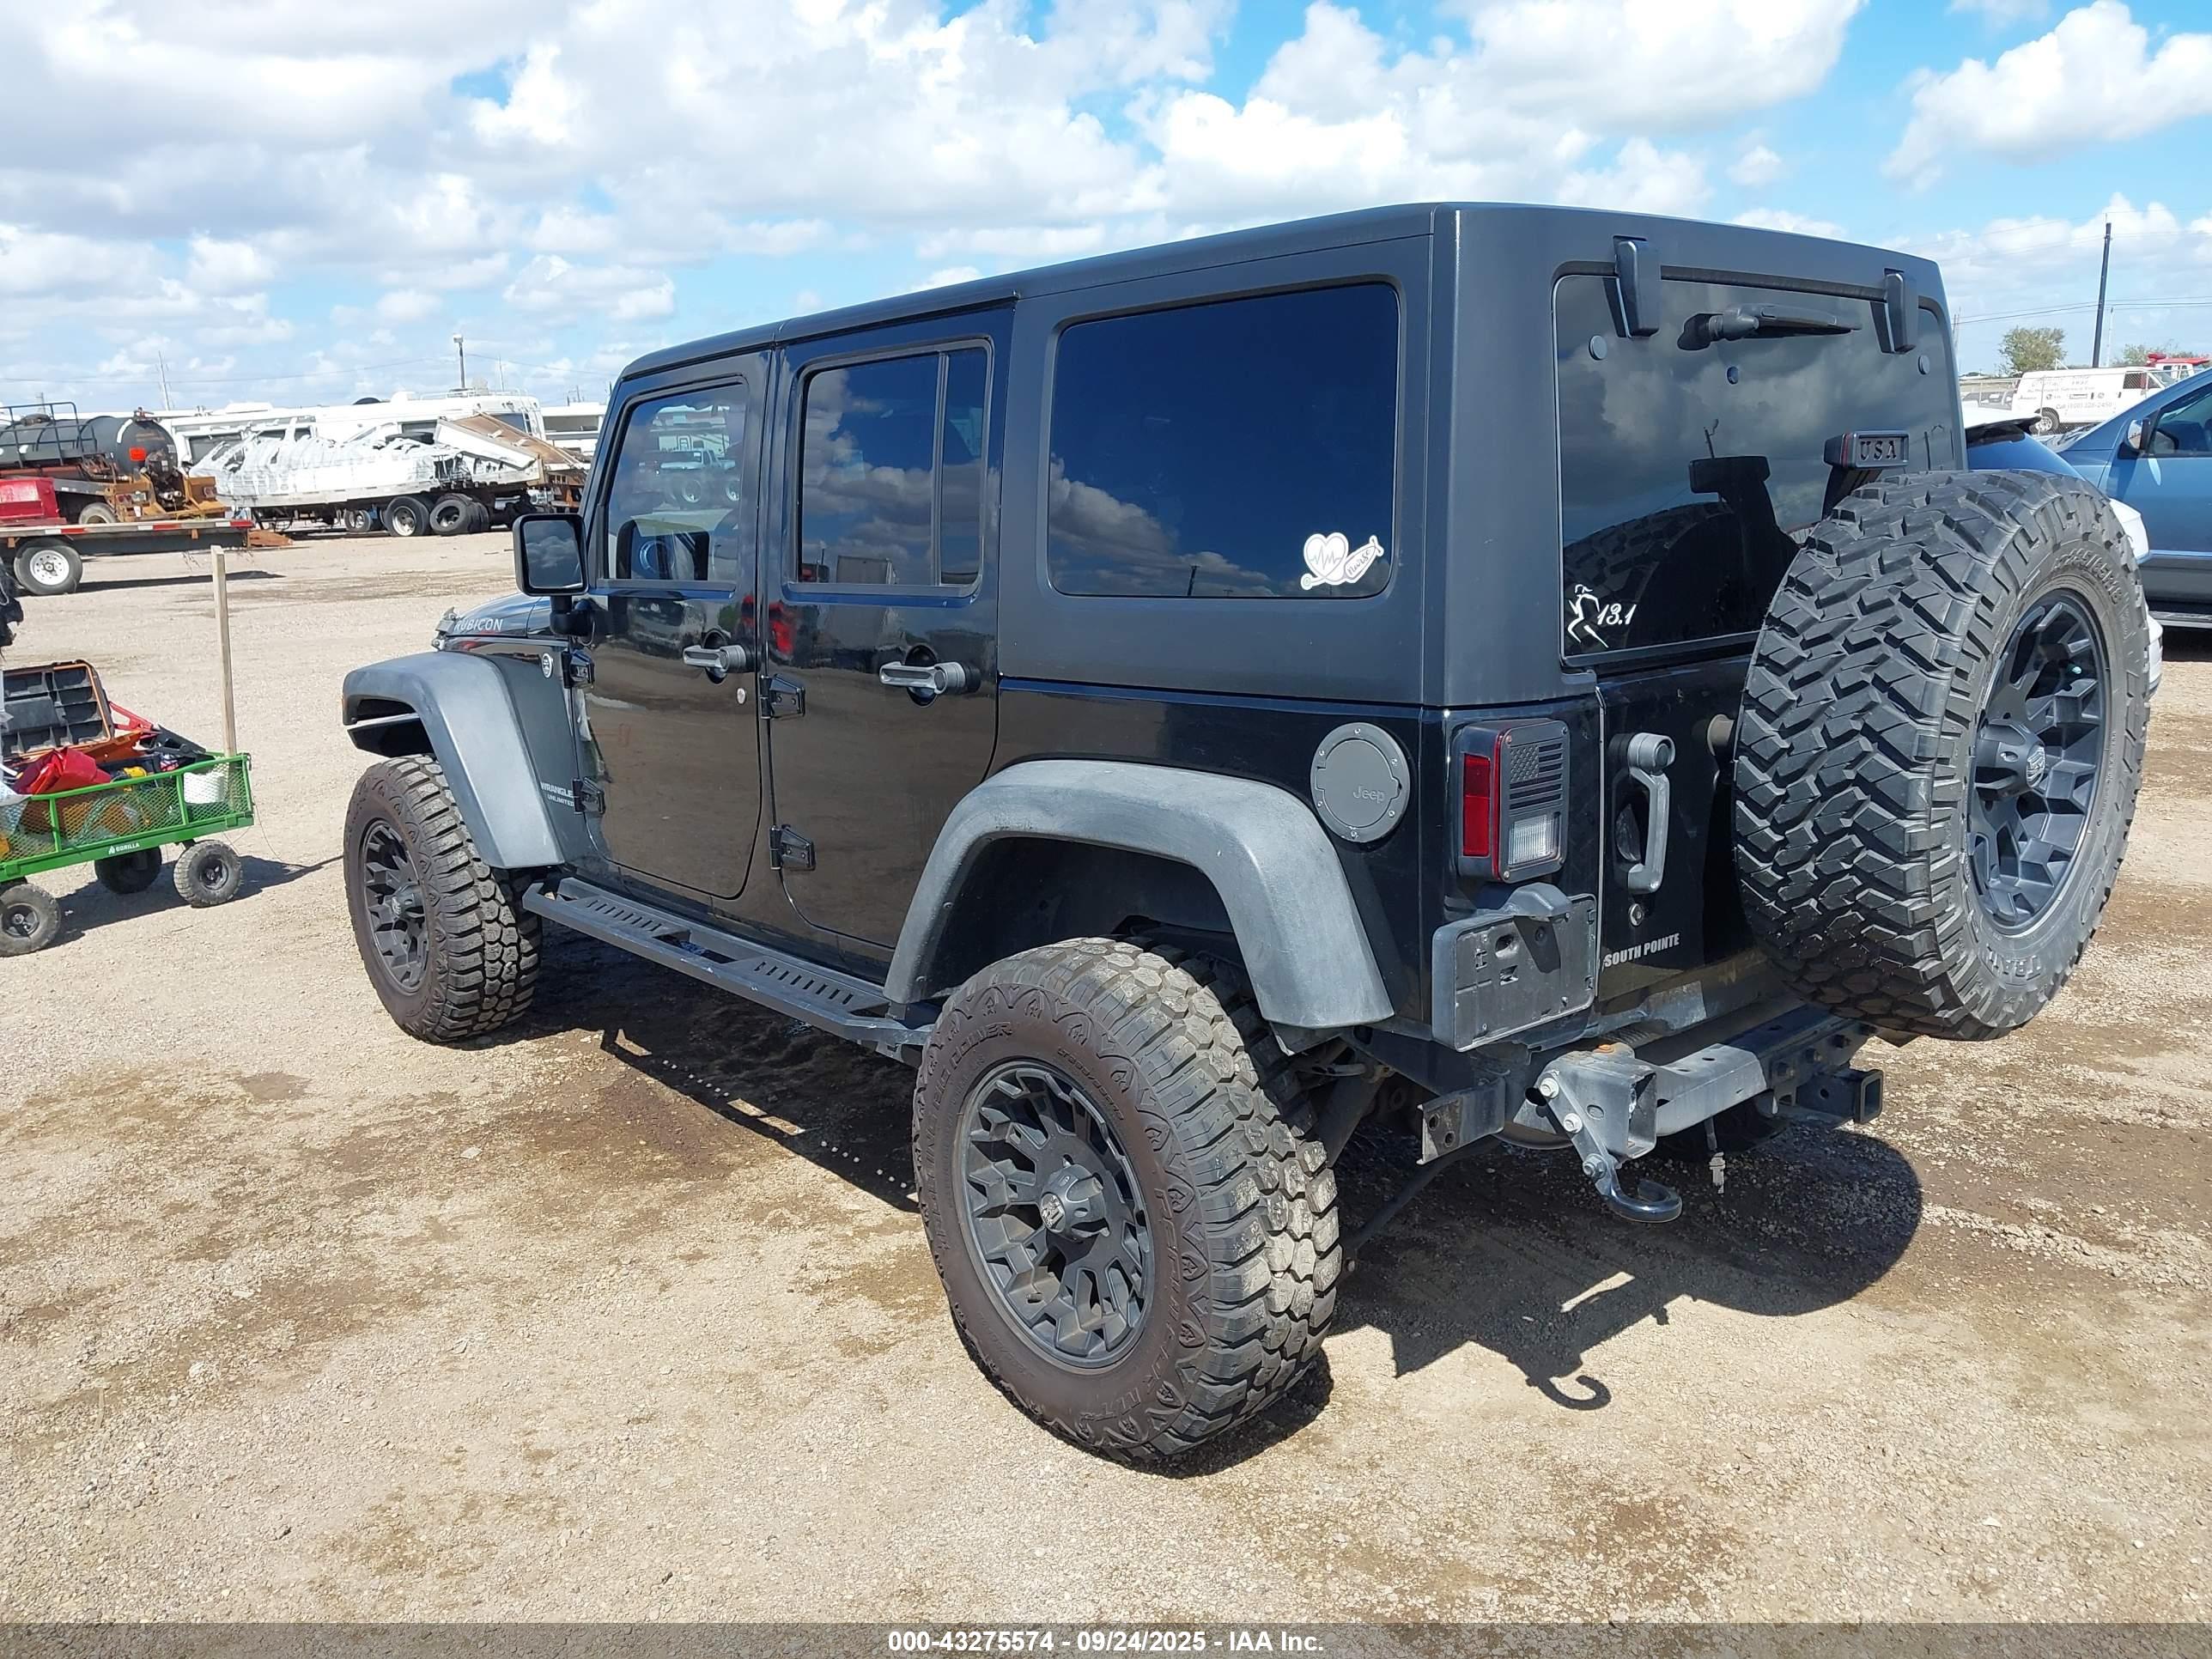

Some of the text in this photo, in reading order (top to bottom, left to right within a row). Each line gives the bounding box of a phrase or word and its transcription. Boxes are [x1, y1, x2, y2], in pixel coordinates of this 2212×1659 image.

[1859, 439, 1897, 461] USA
[1597, 603, 1637, 625] 13.1
[453, 617, 504, 632] RUBICON
[1352, 785, 1385, 803] Jeep
[116, 842, 141, 852] GORILLA
[1604, 933, 1680, 968] SOUTH POINTE
